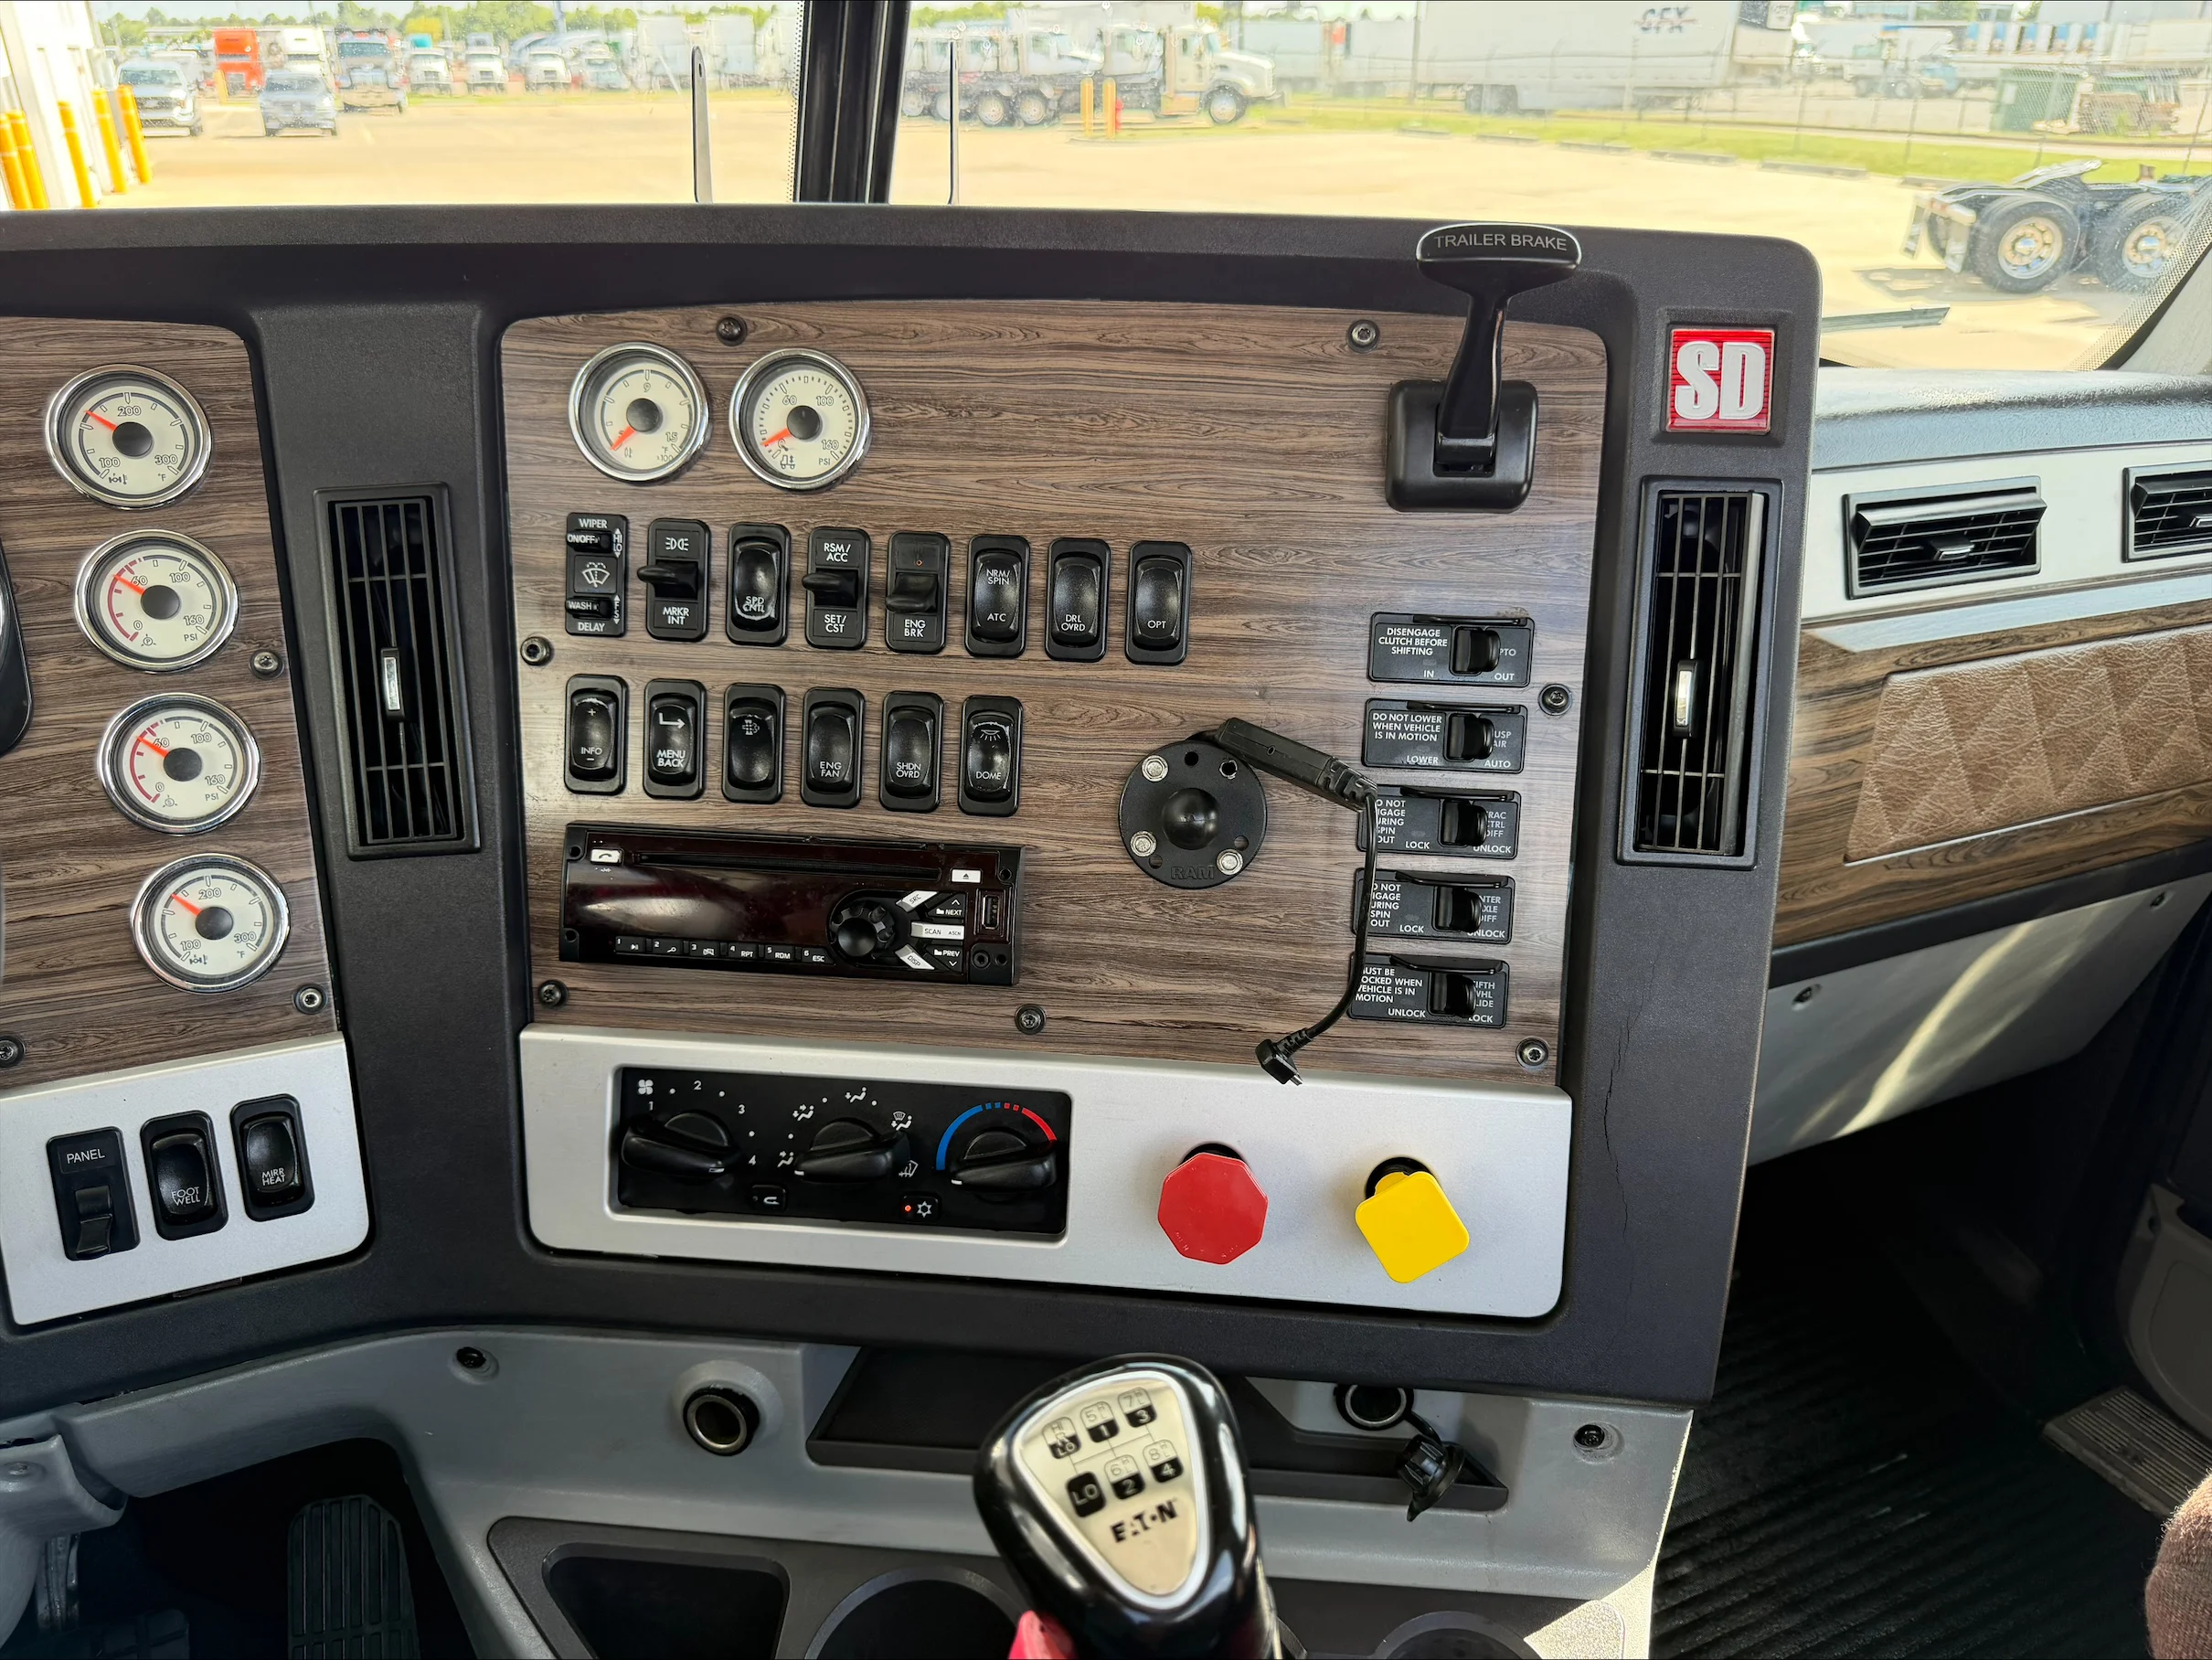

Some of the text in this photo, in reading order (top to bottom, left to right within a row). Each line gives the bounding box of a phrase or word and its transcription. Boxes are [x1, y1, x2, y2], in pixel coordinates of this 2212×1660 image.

[1434, 233, 1568, 251] TRAILER BRAKE
[1674, 340, 1766, 420] SD
[643, 382, 652, 392] 9
[782, 394, 797, 405] 60
[815, 395, 834, 406] 100
[117, 405, 142, 417] 200
[665, 431, 678, 442] 15
[821, 439, 839, 451] 160
[99, 456, 121, 468] 100
[154, 453, 178, 465] 300
[579, 518, 607, 528] WIPER
[567, 534, 595, 544] ON/OFF
[612, 534, 622, 543] HI
[613, 543, 622, 552] LO
[824, 542, 851, 553] RSM/
[826, 552, 848, 562] ACC
[169, 571, 191, 583] 100
[986, 569, 1010, 578] NRM/
[131, 575, 148, 586] 60
[987, 576, 1010, 585] SPIN
[567, 601, 591, 610] WASH
[614, 601, 620, 610] F
[745, 596, 764, 605] SPD
[663, 607, 689, 617] MRKR
[742, 603, 765, 613] CNTL
[614, 610, 620, 618] S
[824, 613, 846, 624] SET/
[986, 612, 1006, 622] ATC
[1065, 613, 1081, 622] DRL
[184, 614, 205, 626] 160
[668, 616, 686, 625] INT
[904, 619, 926, 629] ENG
[1147, 620, 1166, 630] OPT
[133, 620, 143, 631] 0
[578, 622, 605, 632] DELAY
[825, 622, 845, 633] CST
[1060, 622, 1085, 632] OVRD
[184, 633, 197, 642] PSI
[904, 627, 924, 638] BRK
[1387, 627, 1441, 638] DISENGAGE
[1378, 636, 1448, 647] CLUTCH BEFORE
[1391, 646, 1433, 656] SHIFTING
[1500, 648, 1516, 656] PTO
[1423, 670, 1434, 678] IN
[1494, 672, 1515, 681] OUT
[1373, 712, 1442, 724] DO NOT LOWER
[1373, 721, 1441, 733] WHEN VEHICLE
[191, 732, 212, 744] 100
[1375, 731, 1438, 742] IS IN MOTION
[1494, 730, 1512, 739] USP
[153, 737, 170, 748] 60
[580, 746, 602, 756] INFO
[656, 749, 686, 760] MENU
[657, 757, 685, 768] BACK
[1406, 755, 1439, 764] LOWER
[1484, 760, 1511, 768] AUTO
[820, 761, 842, 770] ENG
[896, 761, 921, 771] SHDN
[821, 769, 840, 777] FAN
[896, 769, 920, 778] OVRD
[975, 771, 1002, 781] DOME
[205, 774, 226, 786] 160
[154, 782, 165, 793] 0
[205, 793, 218, 801] PSI
[1385, 799, 1406, 808] NOT
[1377, 808, 1406, 816] GAGE
[1486, 811, 1507, 819] RAC
[1405, 841, 1430, 849] LOCK
[1473, 845, 1512, 854] UNLOCK
[1170, 866, 1215, 880] RAM
[1380, 883, 1401, 892] NOT
[198, 888, 222, 899] 200
[909, 893, 921, 904] SRC
[1372, 891, 1401, 901] GAGE
[1479, 895, 1501, 904] NTER
[1371, 900, 1399, 910] URING
[1482, 905, 1498, 913] XLE
[1370, 910, 1391, 919] SPIN
[1370, 919, 1390, 928] OUT
[1399, 924, 1424, 933] LOCK
[234, 931, 257, 943] 300
[180, 939, 201, 951] 100
[774, 952, 791, 960] RDM
[907, 955, 920, 966] DISP
[1363, 966, 1395, 976] UST BE
[1361, 975, 1423, 987] OCKED WHEN
[1473, 980, 1495, 989] IFTH
[1394, 986, 1402, 995] IS
[1405, 987, 1416, 995] IN
[1355, 993, 1394, 1003] MOTION
[1476, 999, 1494, 1008] IDE
[1388, 1007, 1426, 1018] UNLOCK
[694, 1080, 702, 1091] 2
[648, 1101, 654, 1111] 1
[738, 1104, 745, 1114] 3
[66, 1148, 105, 1164] PANEL
[748, 1155, 757, 1165] 4
[261, 1167, 285, 1179] MIRR
[261, 1174, 286, 1186] HEAT
[171, 1186, 200, 1198] FOOT
[173, 1194, 201, 1206] WELL
[1122, 1395, 1133, 1407] 7
[1085, 1409, 1097, 1421] 5
[1136, 1409, 1150, 1423] 3
[1100, 1424, 1110, 1437] 1
[1057, 1442, 1075, 1456] LO
[1148, 1448, 1161, 1460] 8
[1110, 1463, 1122, 1476] 6
[1161, 1463, 1175, 1476] 4
[1122, 1479, 1138, 1495] 2
[1071, 1483, 1100, 1506] LO
